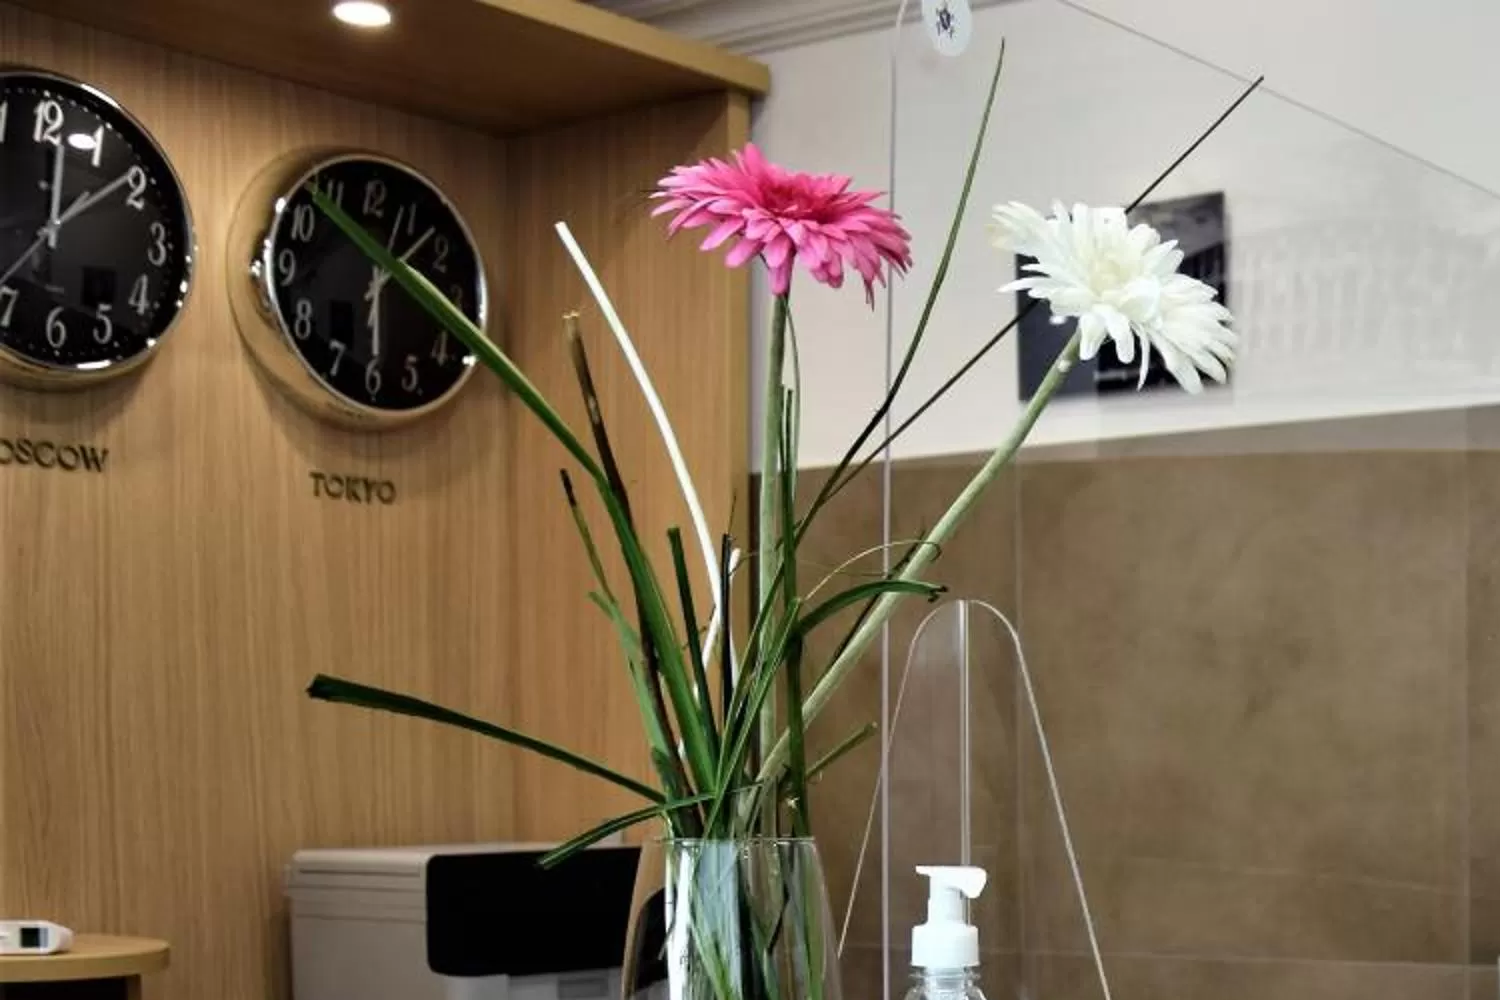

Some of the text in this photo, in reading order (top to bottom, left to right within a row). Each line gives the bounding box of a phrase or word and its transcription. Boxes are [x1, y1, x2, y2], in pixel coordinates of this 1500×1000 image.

[33, 100, 64, 145] 12
[126, 166, 146, 210] 2
[363, 180, 387, 219] 12
[291, 204, 315, 243] 10
[148, 222, 166, 266] 3
[433, 234, 448, 273] 2
[279, 249, 296, 286] 9
[1, 285, 19, 327] 7
[129, 274, 149, 316] 4
[46, 306, 66, 348] 6
[93, 303, 113, 344] 5
[295, 300, 312, 339] 8
[330, 339, 346, 376] 7
[365, 358, 381, 394] 6
[402, 355, 419, 392] 5
[309, 471, 397, 505] TOKYO
